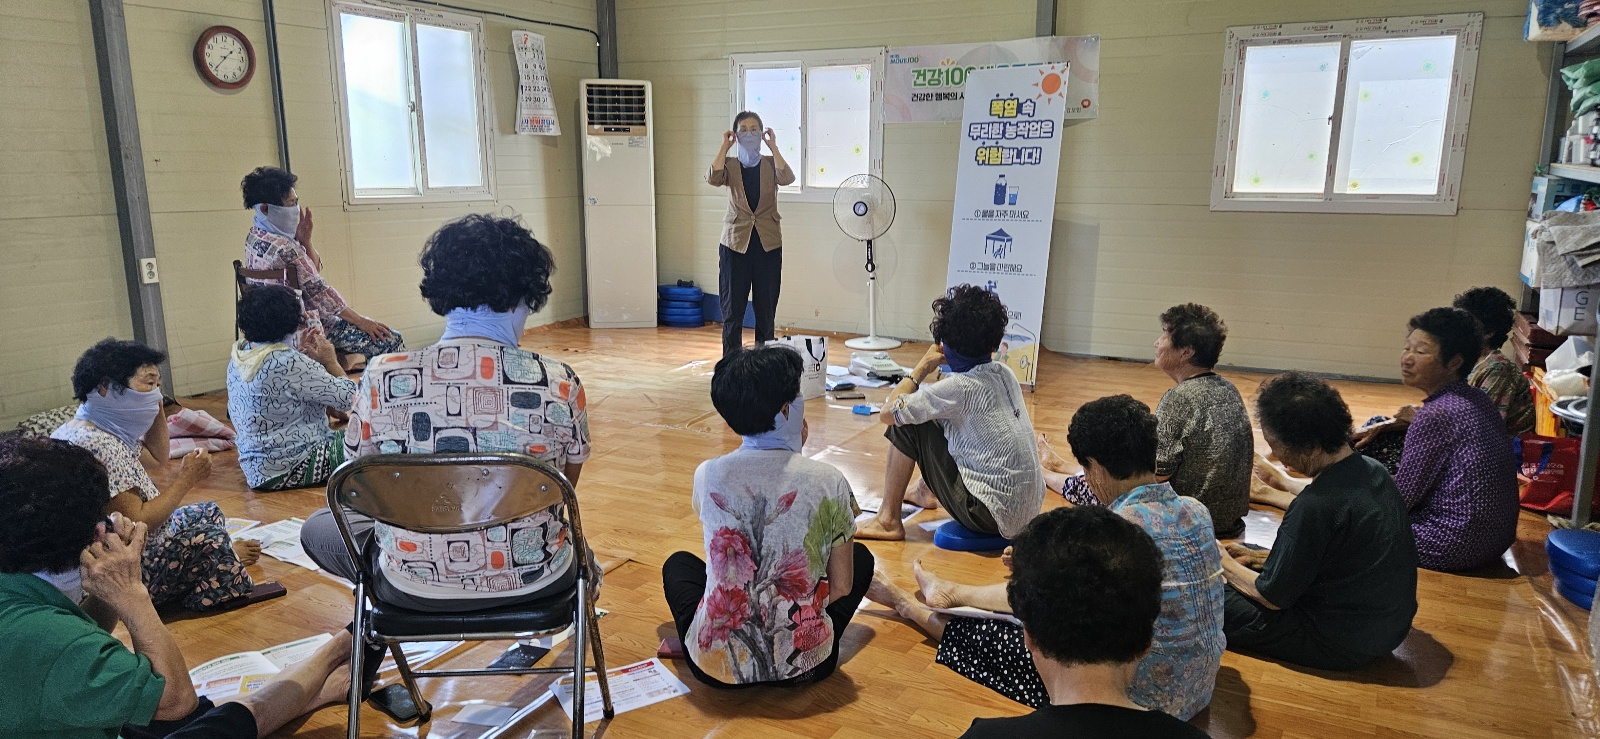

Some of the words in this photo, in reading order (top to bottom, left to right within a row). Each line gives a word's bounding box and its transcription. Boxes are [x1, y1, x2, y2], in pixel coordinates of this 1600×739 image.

[221, 35, 228, 43] 12
[911, 92, 933, 102] 건강한
[935, 91, 958, 101] 행복의
[990, 98, 1019, 118] 폭염
[1021, 98, 1036, 117] 속
[968, 122, 1004, 140] 무리한
[1004, 120, 1054, 140] 농작업은
[975, 146, 1042, 166] 위험합니다!
[995, 209, 1009, 219] 자주
